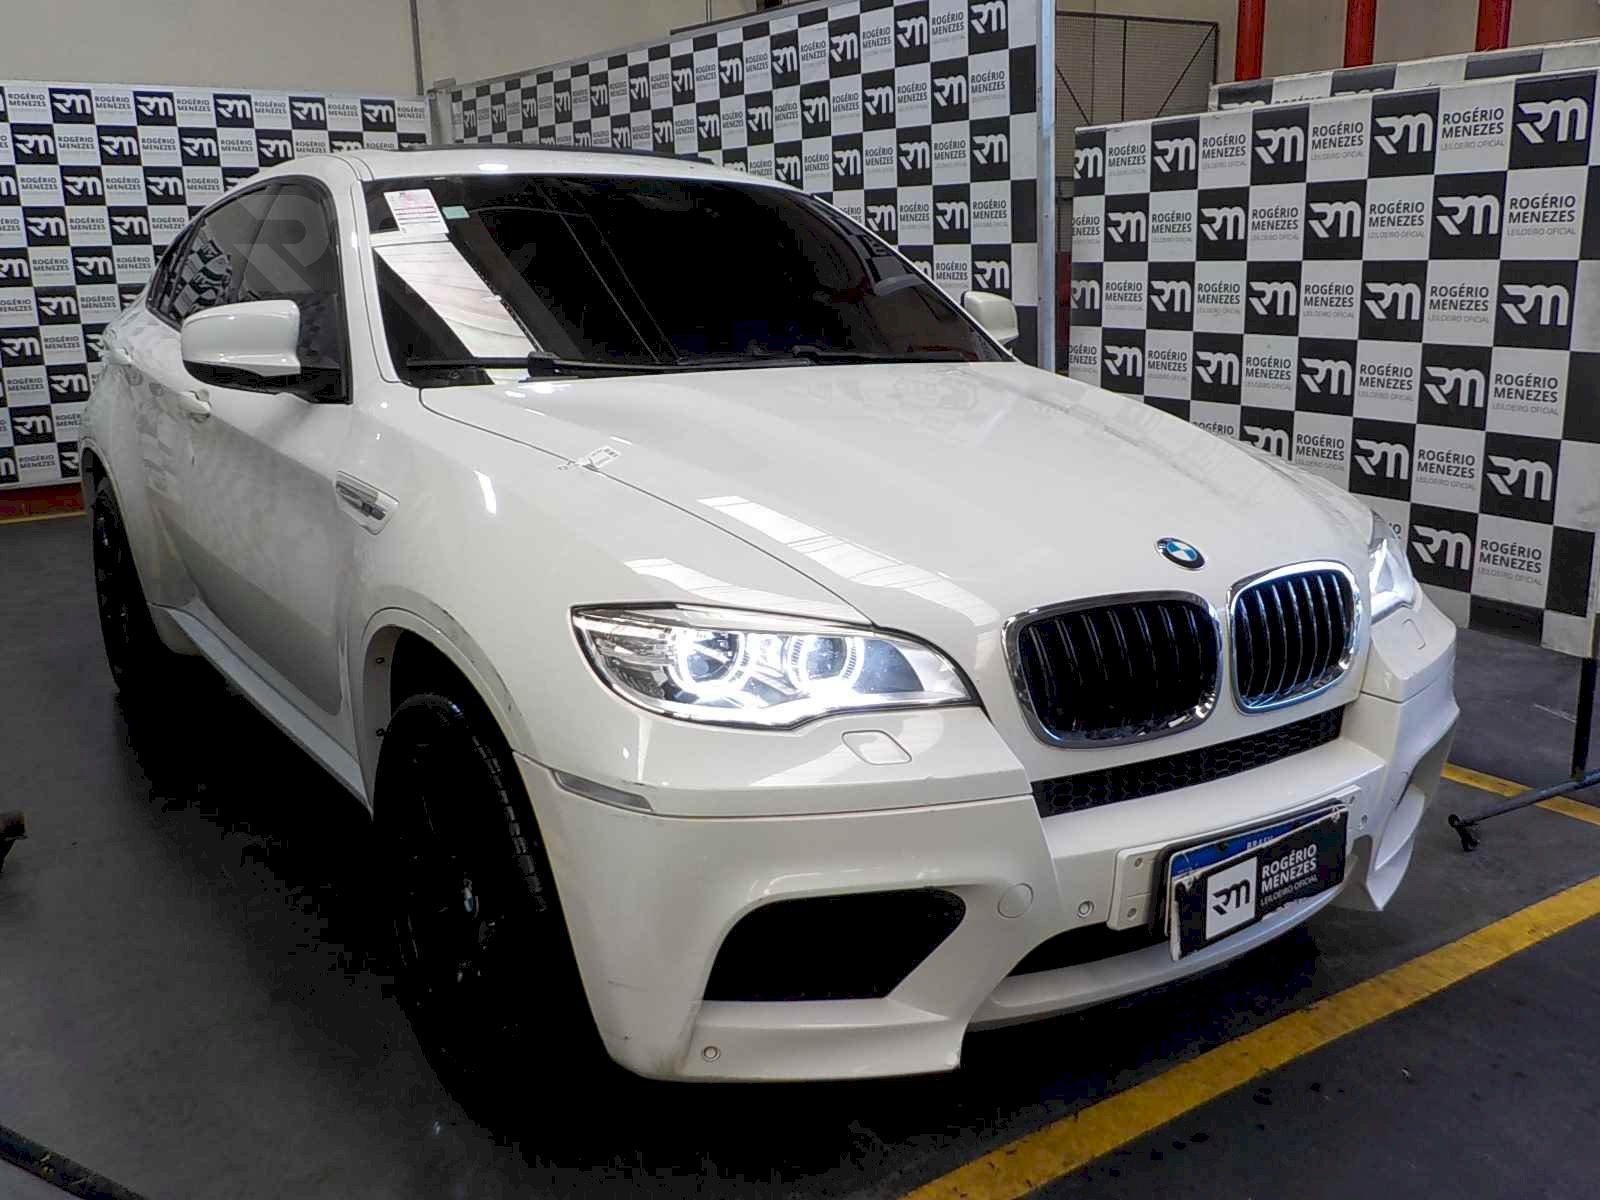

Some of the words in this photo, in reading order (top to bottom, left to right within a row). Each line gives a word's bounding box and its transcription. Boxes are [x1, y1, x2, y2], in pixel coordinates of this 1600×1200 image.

[932, 11, 964, 26] ROGÉRIO
[932, 22, 964, 36] MENEZES
[971, 70, 1005, 83] ROGÉRIO
[897, 82, 927, 94] ROGÉRIO
[971, 81, 1005, 94] MENEZES
[897, 92, 927, 104] MENEZES
[1443, 107, 1504, 125] ROGÉRIO
[1312, 120, 1364, 137] ROGÉRIO
[1442, 122, 1504, 138] MENEZES
[934, 139, 966, 151] ROGÉRIO
[1203, 134, 1246, 148] ROGÉRIO
[1312, 134, 1364, 150] MENEZES
[934, 149, 966, 160] MENEZES
[1108, 144, 1146, 156] ROGÉRIO
[1202, 146, 1246, 160] MENEZES
[1108, 154, 1146, 167] MENEZES
[973, 199, 1007, 210] ROGÉRIO
[1369, 199, 1424, 215] ROGÉRIO
[1510, 194, 1575, 210] ROGÉRIO
[973, 210, 1007, 220] MENEZES
[1152, 211, 1192, 223] ROGÉRIO
[1252, 206, 1298, 219] ROGÉRIO
[1508, 209, 1575, 224] MENEZES
[1152, 222, 1192, 234] MENEZES
[1252, 218, 1298, 231] MENEZES
[1368, 215, 1424, 228] MENEZES
[1105, 280, 1142, 291] ROGÉRIO
[1198, 281, 1240, 293] ROGÉRIO
[1304, 282, 1354, 296] ROGÉRIO
[1430, 283, 1489, 298] ROGÉRIO
[1105, 291, 1142, 302] MENEZES
[1197, 293, 1240, 305] MENEZES
[1304, 294, 1354, 308] MENEZES
[1429, 298, 1489, 312] MENEZES
[1148, 348, 1187, 361] ROGÉRIO
[1148, 360, 1187, 372] MENEZES
[1246, 355, 1291, 369] ROGÉRIO
[1246, 368, 1291, 381] MENEZES
[1361, 363, 1412, 378] ROGÉRIO
[1360, 376, 1412, 391] MENEZES
[1495, 373, 1558, 389] ROGÉRIO
[1494, 387, 1558, 403] MENEZES
[1296, 433, 1344, 449] ROGÉRIO
[1296, 446, 1344, 462] MENEZES
[1418, 448, 1475, 466] ROGÉRIO
[1417, 462, 1474, 479] MENEZES
[1481, 539, 1542, 560] ROGÉRIO
[1479, 552, 1542, 574] MENEZES
[1262, 843, 1317, 878] ROGÉRIO
[1261, 858, 1317, 895] MENEZES
[1294, 876, 1318, 893] OFICIAL
